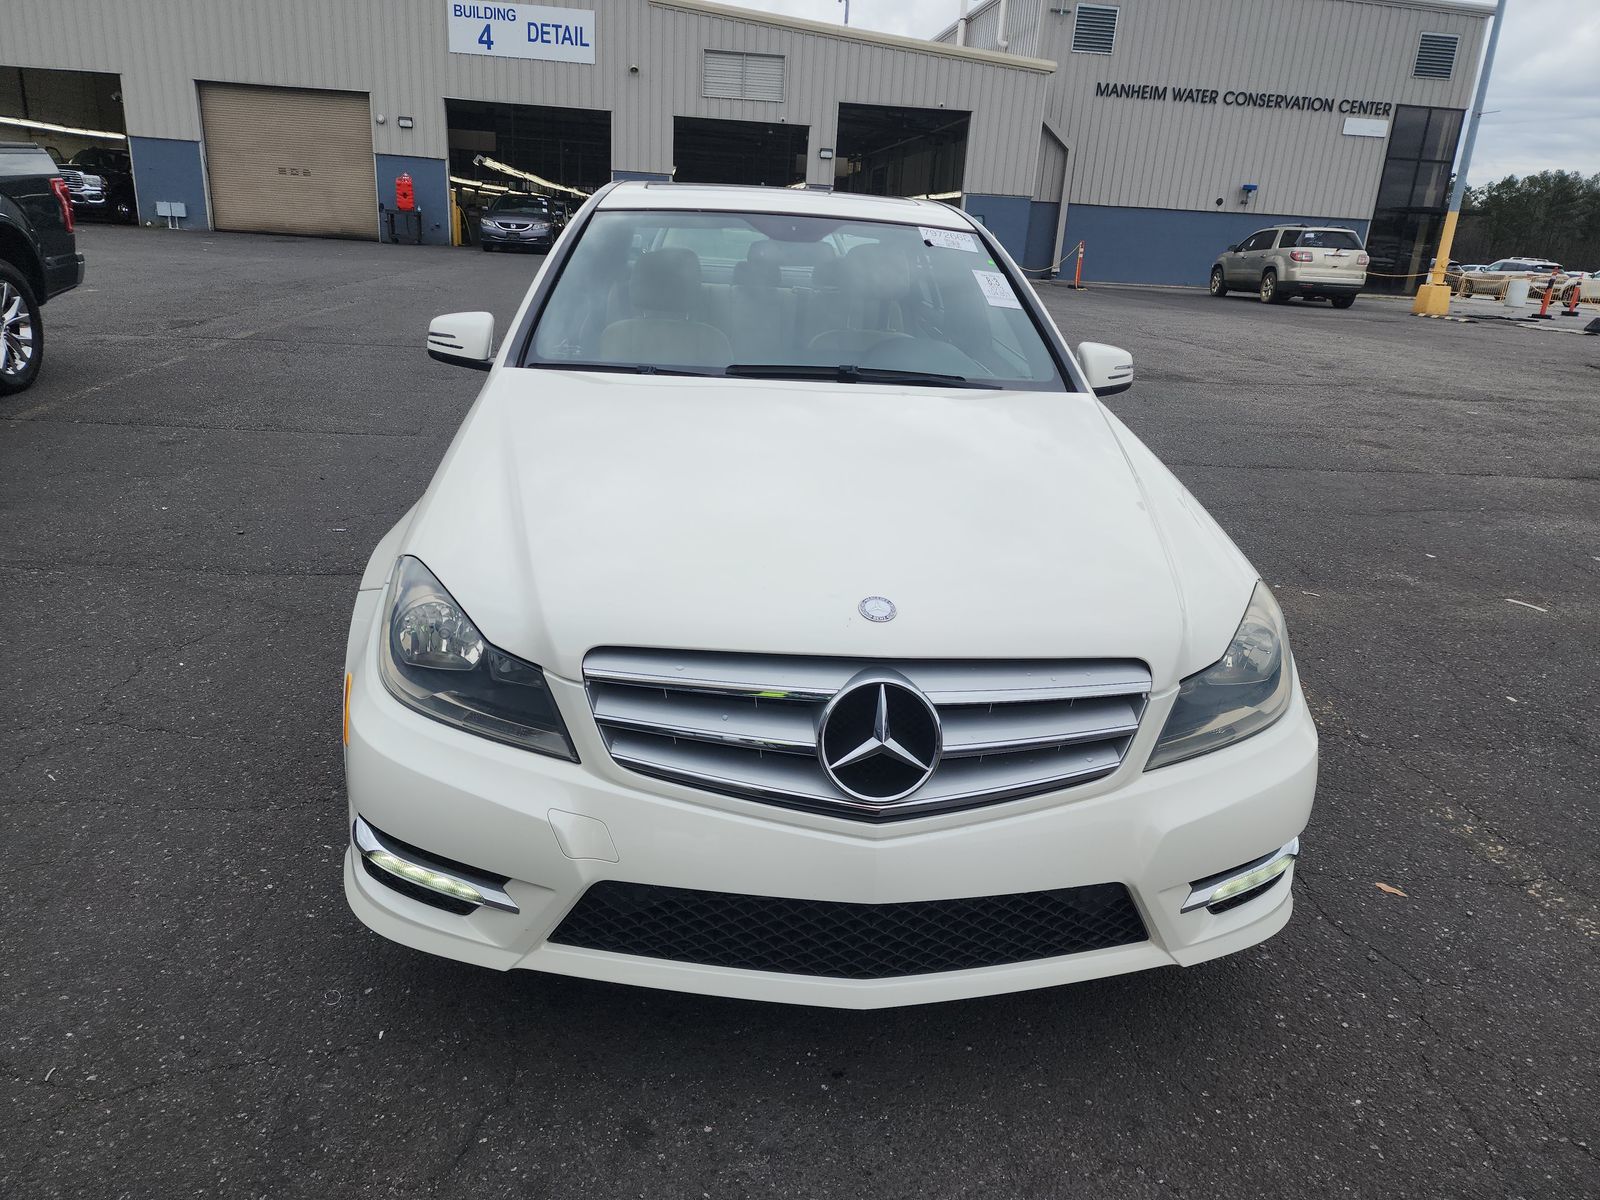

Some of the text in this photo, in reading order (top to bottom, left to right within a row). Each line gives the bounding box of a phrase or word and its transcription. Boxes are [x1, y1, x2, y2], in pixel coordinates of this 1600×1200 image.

[453, 4, 517, 22] BUILDING
[478, 23, 494, 50] 4
[527, 22, 590, 47] DETAIL
[1095, 82, 1393, 117] MANHEIM WATER CONSERVATION CENTER
